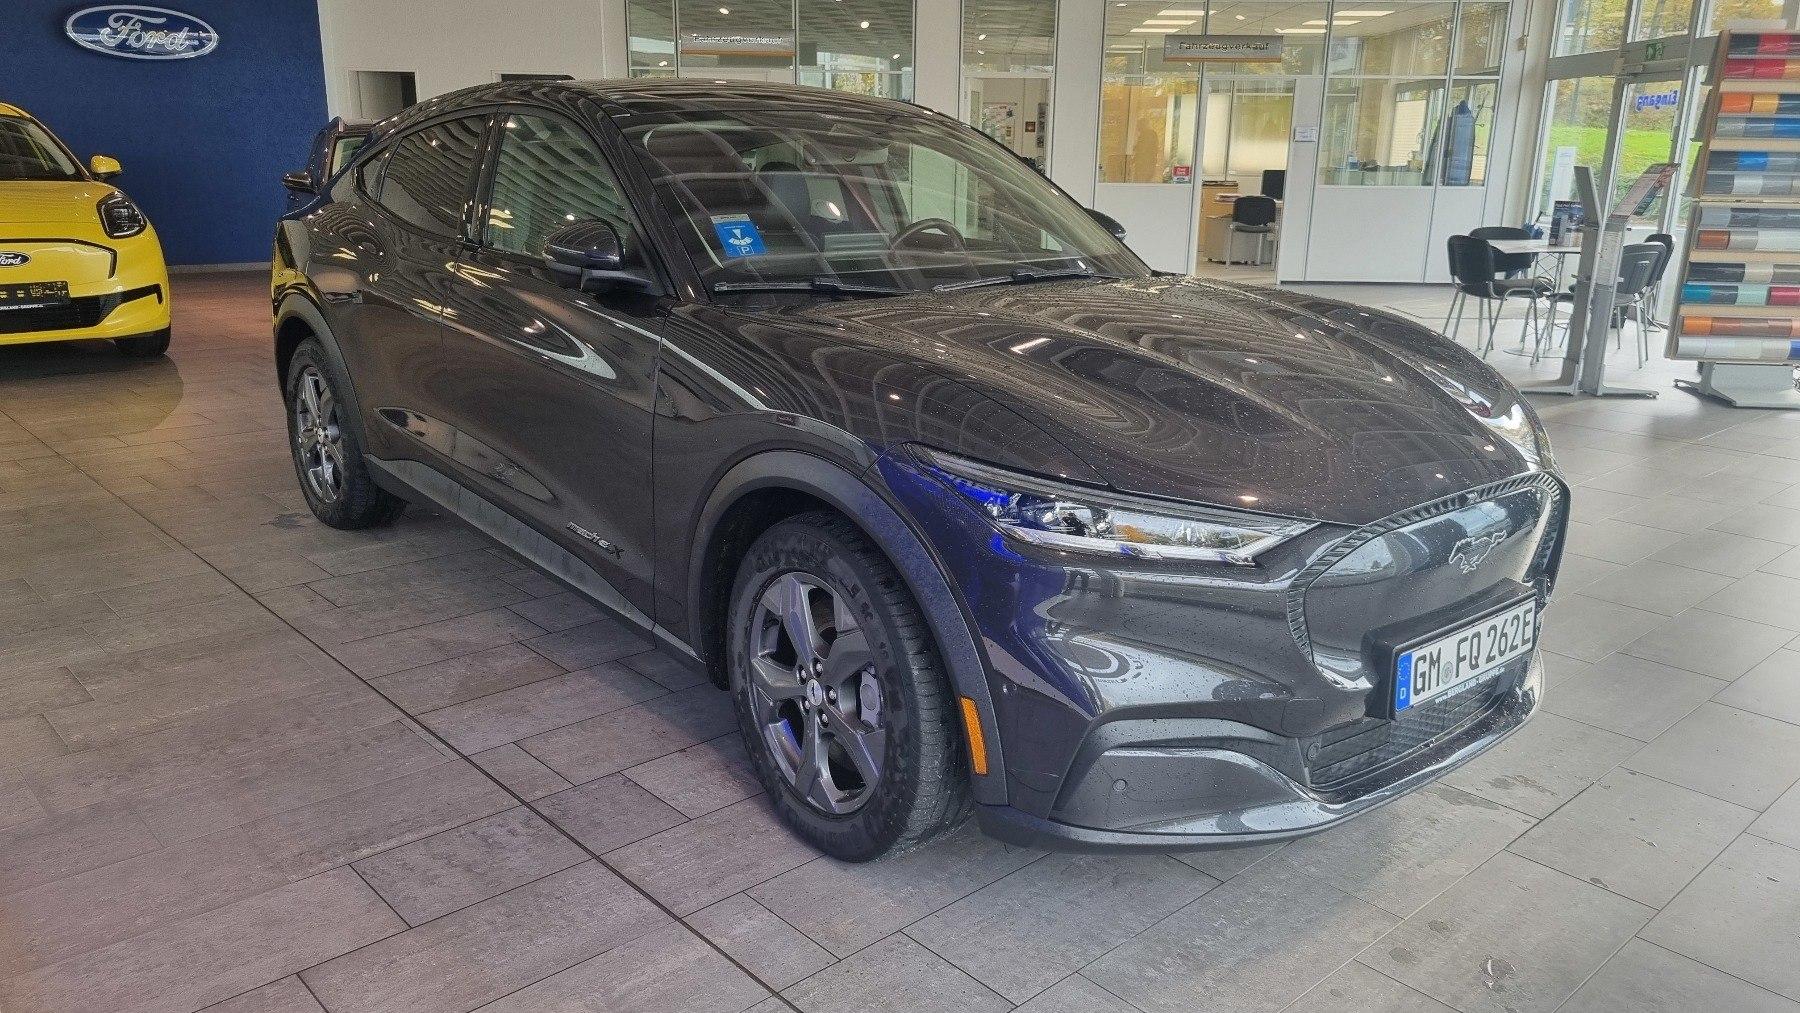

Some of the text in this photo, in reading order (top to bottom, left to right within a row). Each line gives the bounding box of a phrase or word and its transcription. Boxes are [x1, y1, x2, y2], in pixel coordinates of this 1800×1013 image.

[98, 13, 191, 53] Ford
[1178, 41, 1270, 51] Fahrzeugverkauf
[740, 246, 750, 255] P
[1412, 606, 1533, 697] GM FQ 262E
[1400, 687, 1406, 700] D
